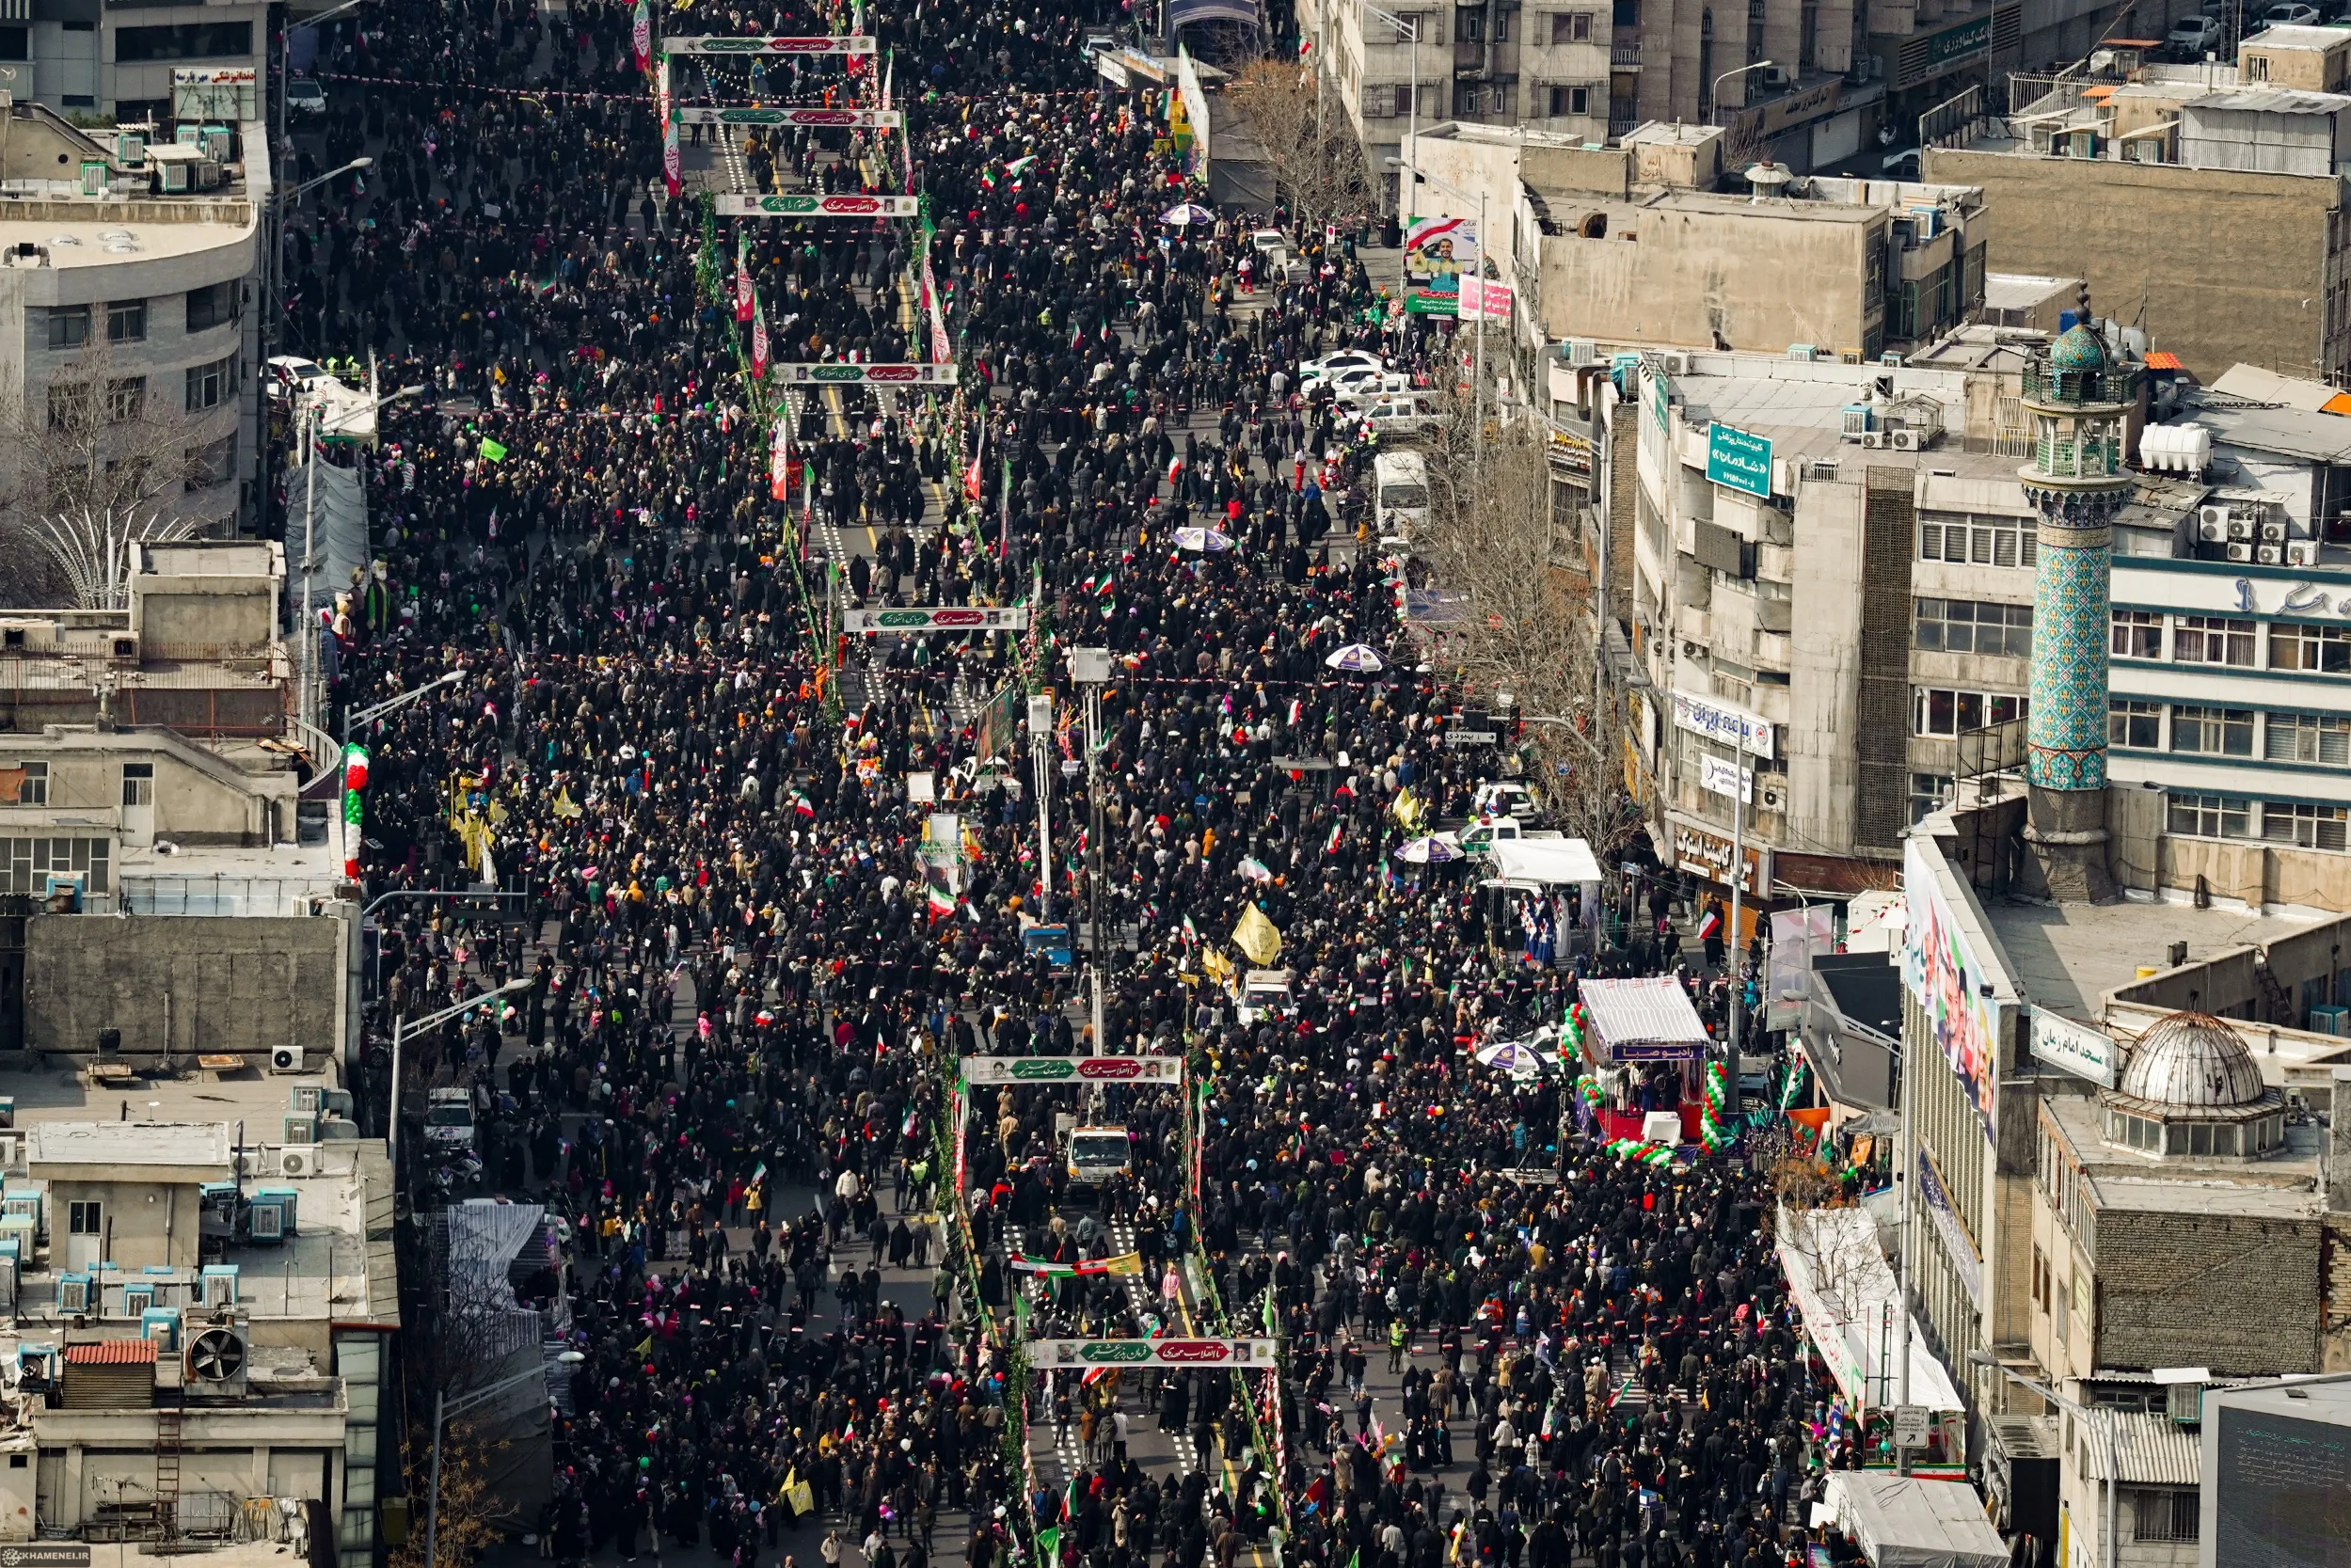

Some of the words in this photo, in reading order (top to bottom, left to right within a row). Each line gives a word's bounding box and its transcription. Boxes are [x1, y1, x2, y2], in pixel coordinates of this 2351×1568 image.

[197, 73, 208, 84] مهر
[212, 71, 256, 83] دندانپزشکی
[826, 199, 844, 211] مهدی
[843, 199, 869, 212] انقلاب
[887, 368, 910, 379] انقلاب
[951, 613, 977, 624] انقلاب
[1693, 703, 1719, 731] ایران
[1446, 732, 1474, 741] بهبودی
[1704, 843, 1731, 870] کابینت
[2042, 1028, 2061, 1053] زمان
[2062, 1037, 2079, 1054] امام
[1623, 1047, 1660, 1059] صبا
[1661, 1046, 1694, 1059] رادیو
[2079, 1046, 2104, 1065] مسجد
[1083, 1061, 1103, 1076] مهدی
[1102, 1062, 1131, 1077] انقلاب
[1130, 1062, 1136, 1075] تا
[1162, 1344, 1190, 1359] مهدی
[1189, 1344, 1215, 1359] انقلاب
[1215, 1344, 1221, 1358] تا
